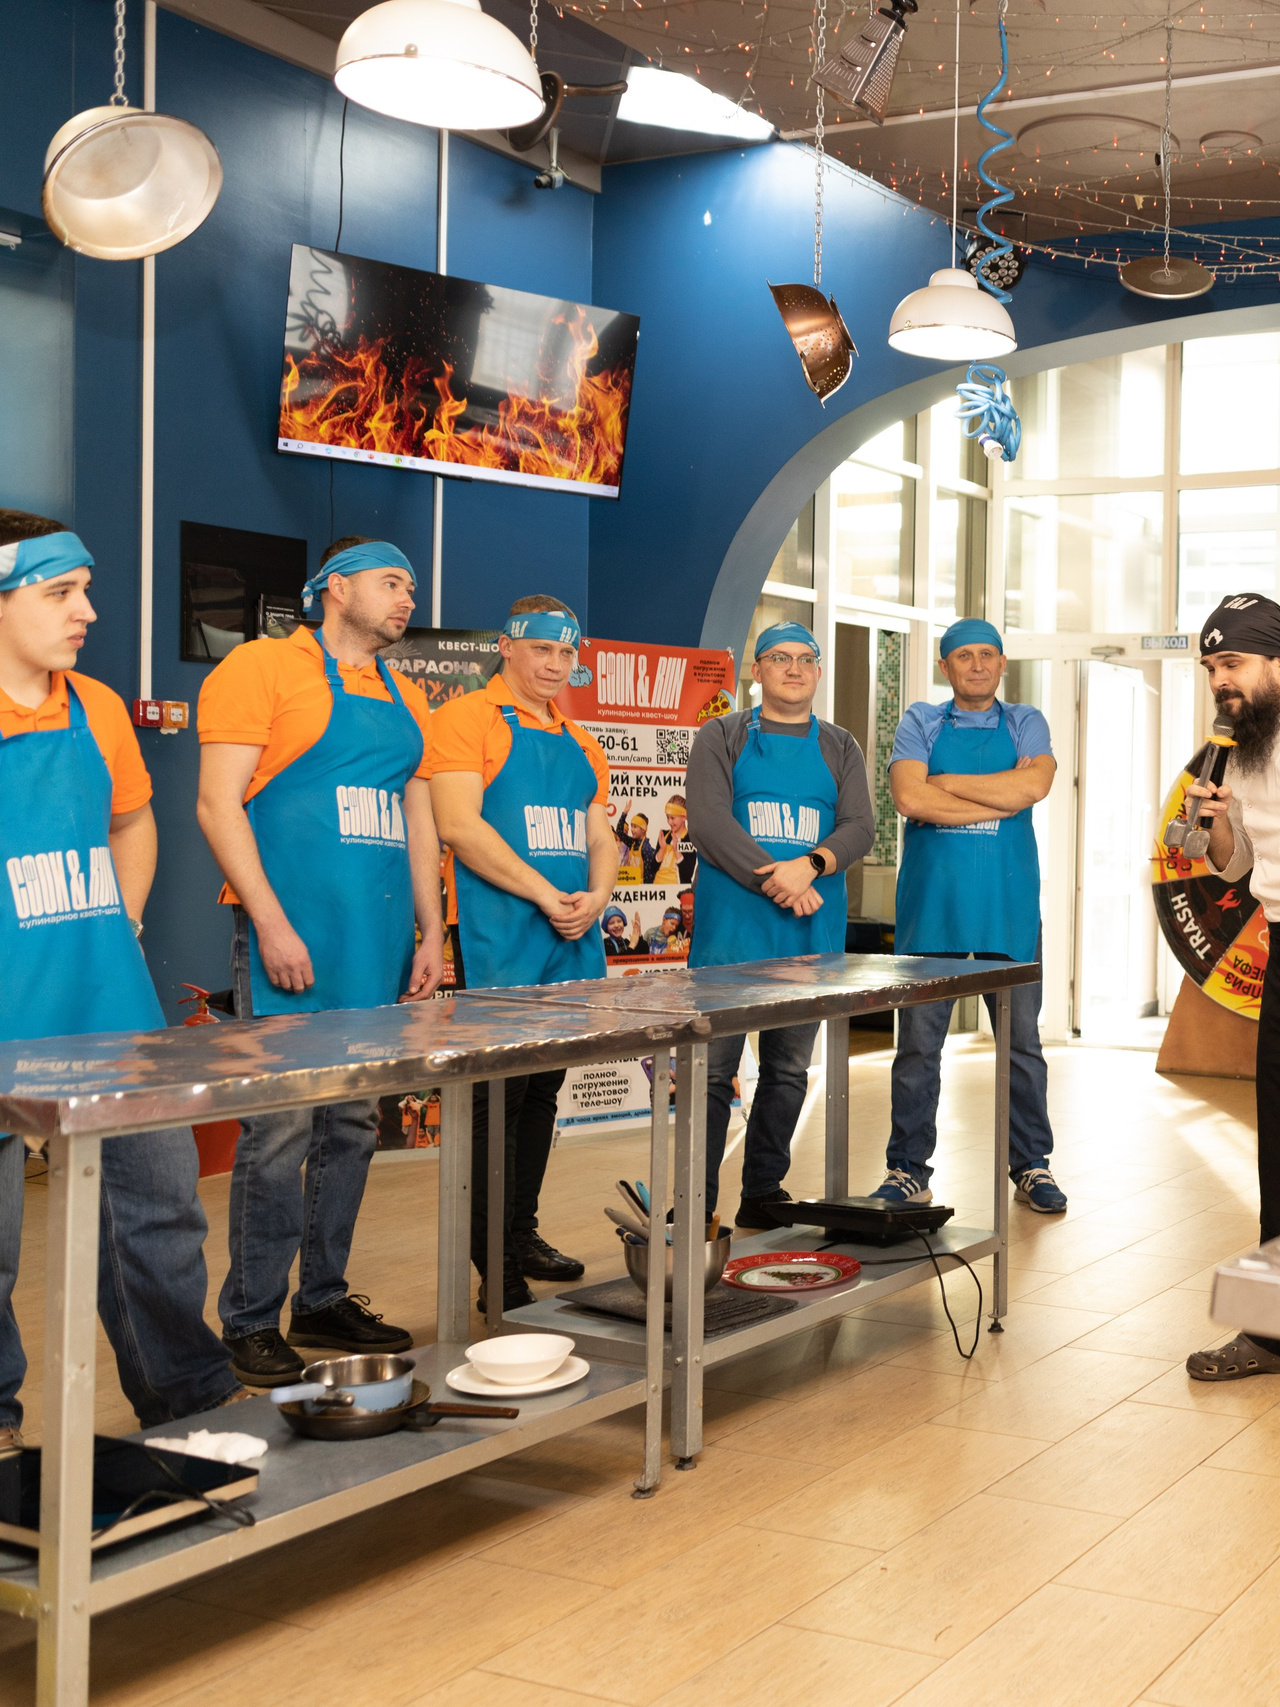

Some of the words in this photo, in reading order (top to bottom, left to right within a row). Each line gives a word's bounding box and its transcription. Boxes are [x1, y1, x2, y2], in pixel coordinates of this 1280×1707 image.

[1143, 636, 1187, 649] ВЫХОД
[384, 657, 482, 676] ФАРАОНА
[597, 650, 636, 708] COOK
[636, 654, 650, 708] &
[650, 656, 687, 710] RUN
[597, 708, 641, 719] кулинарные
[641, 711, 678, 721] квест-шоу
[336, 785, 380, 838] COOK
[379, 789, 391, 840] &
[524, 805, 563, 850] COOK
[560, 807, 574, 850] &
[748, 801, 783, 838] COOK
[782, 803, 795, 840] &
[796, 805, 820, 845] RUN
[969, 829, 998, 837] квест-шоу
[340, 837, 383, 846] кулинарное
[529, 850, 568, 858] кулинарное
[6, 851, 71, 919] COOK
[66, 849, 88, 911] &
[611, 890, 666, 903] ЖДЕНИЯ
[19, 911, 78, 930] кулинарное
[80, 906, 121, 919] квест-шоу
[1171, 892, 1212, 961] TRASH
[583, 1070, 617, 1080] полное
[572, 1078, 629, 1091] погружение
[582, 1087, 629, 1100] культовое
[580, 1097, 623, 1108] теле-шоу
